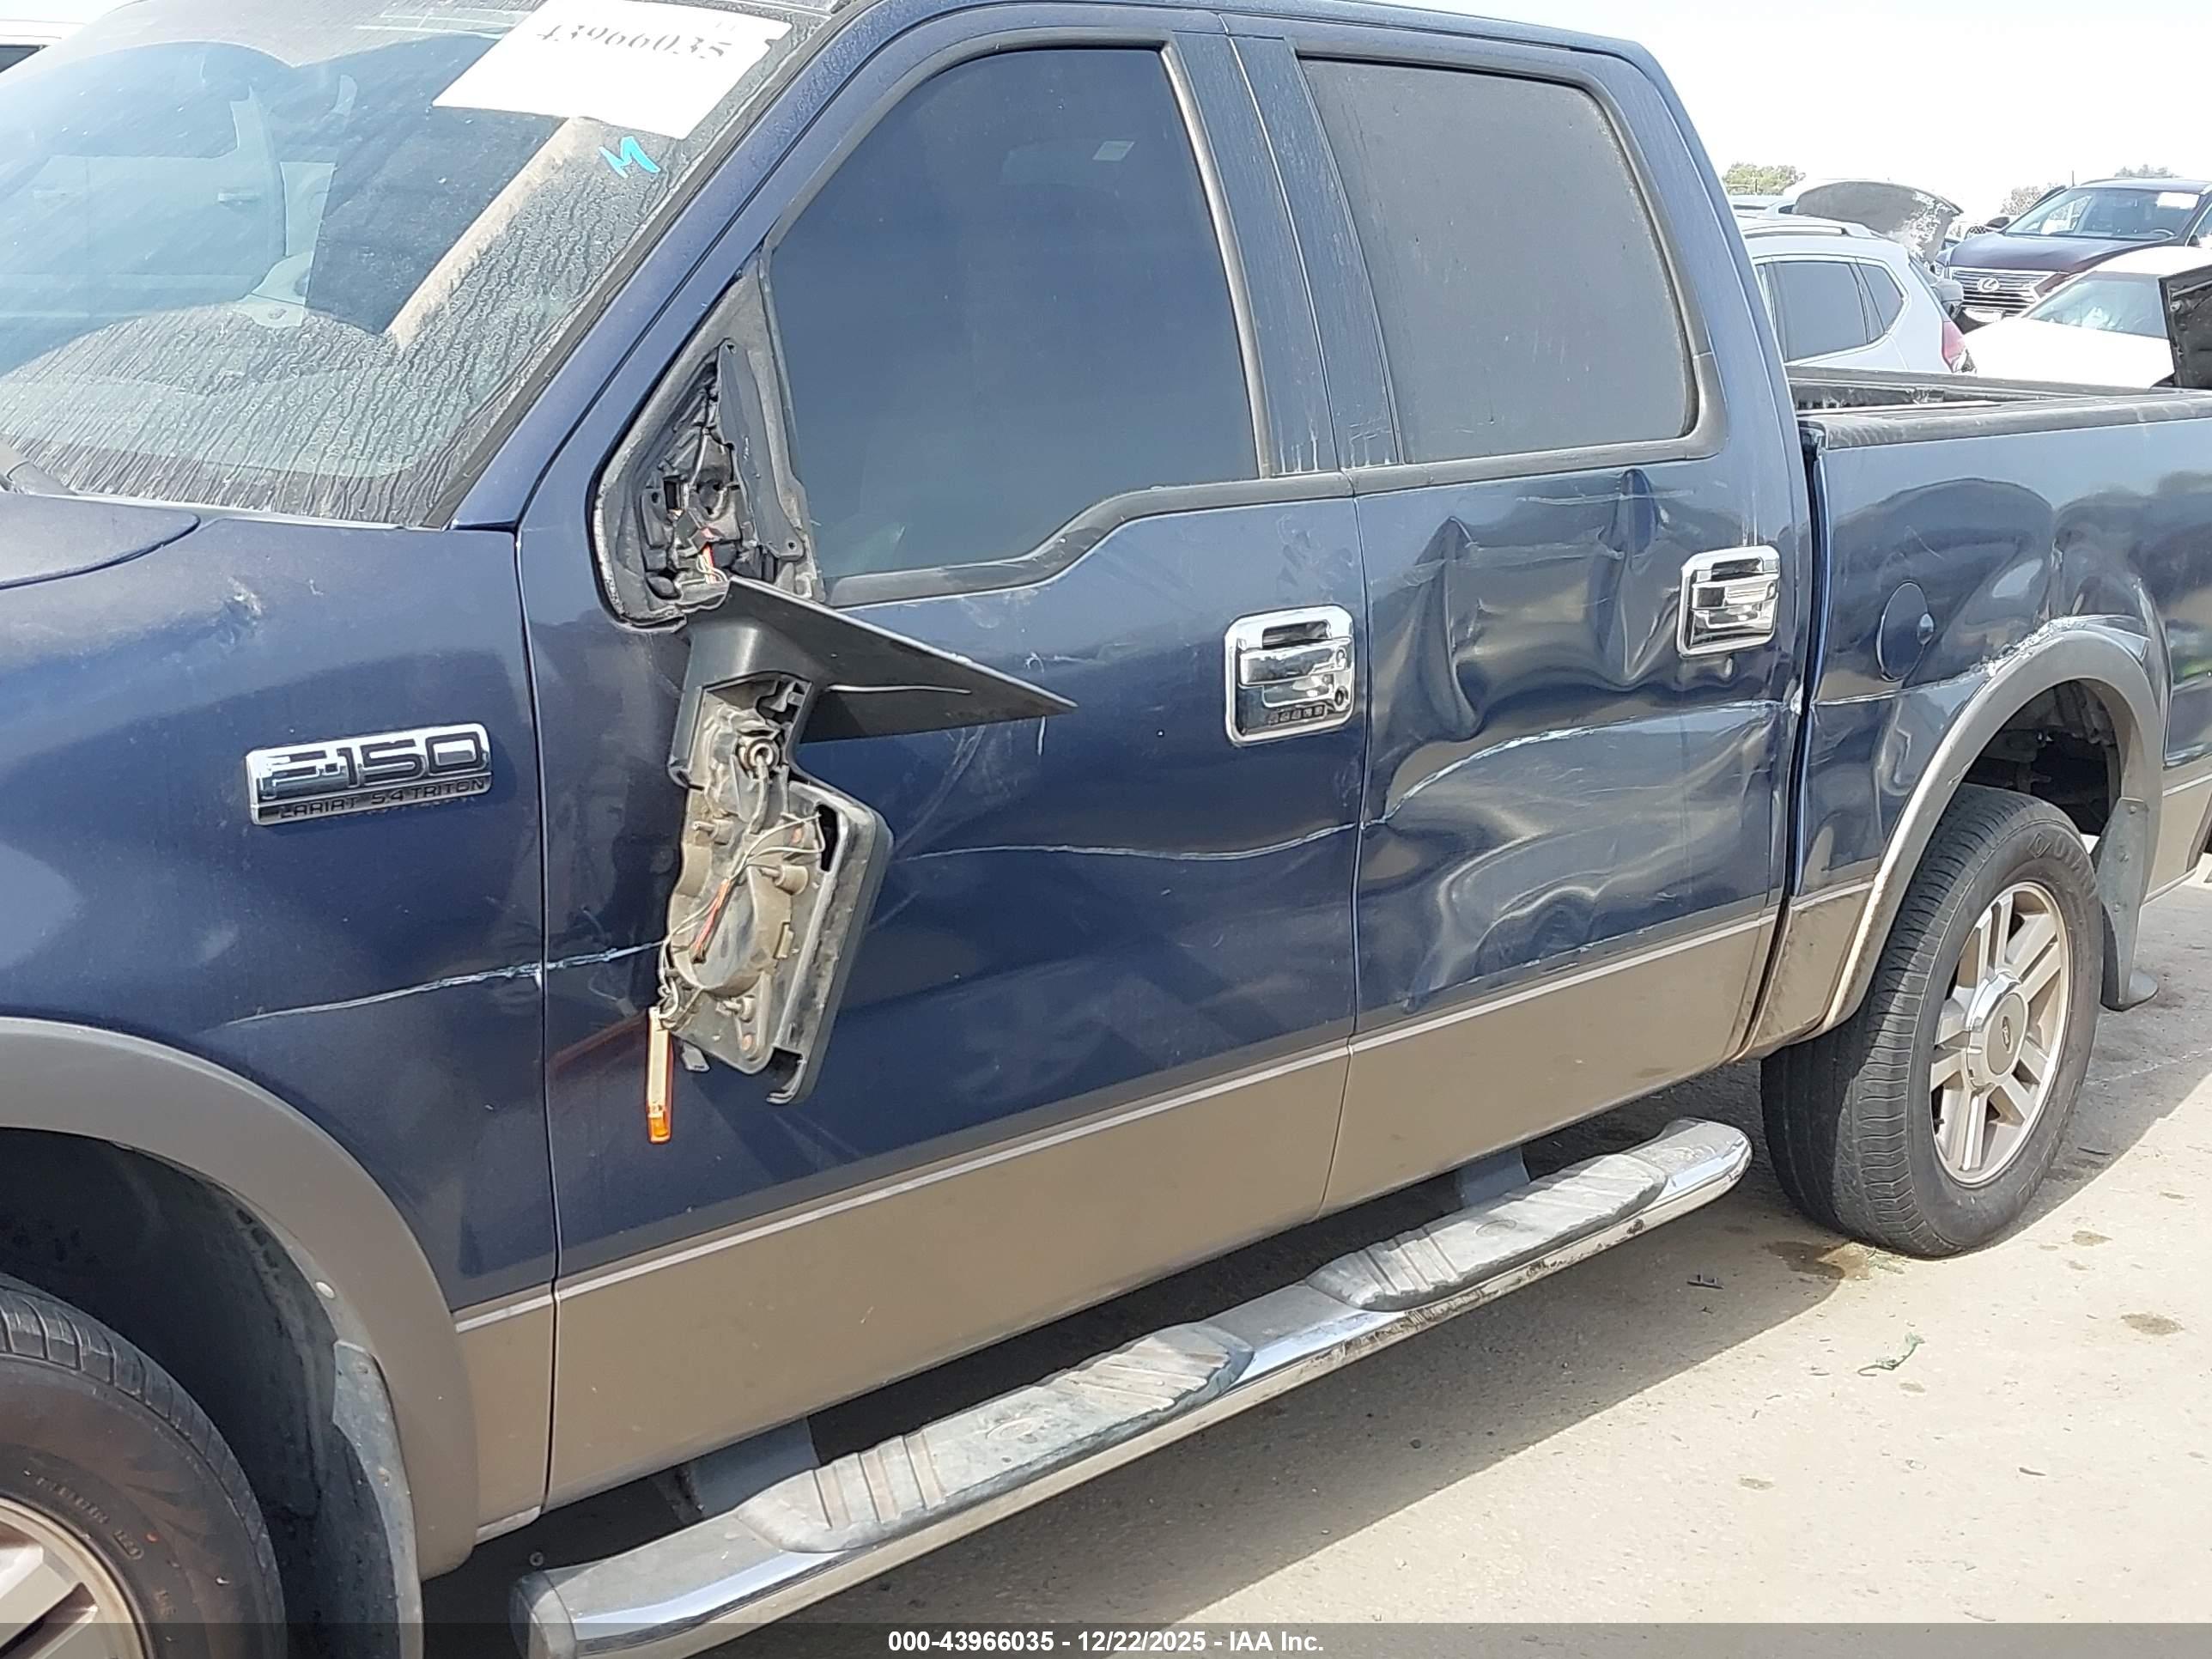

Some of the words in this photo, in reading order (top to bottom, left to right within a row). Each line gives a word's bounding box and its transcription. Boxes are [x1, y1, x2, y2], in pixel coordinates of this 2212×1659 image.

[260, 731, 485, 799] F-150
[278, 795, 359, 818] LARIAT
[371, 788, 404, 805] 5.4
[410, 778, 486, 799] TRITON
